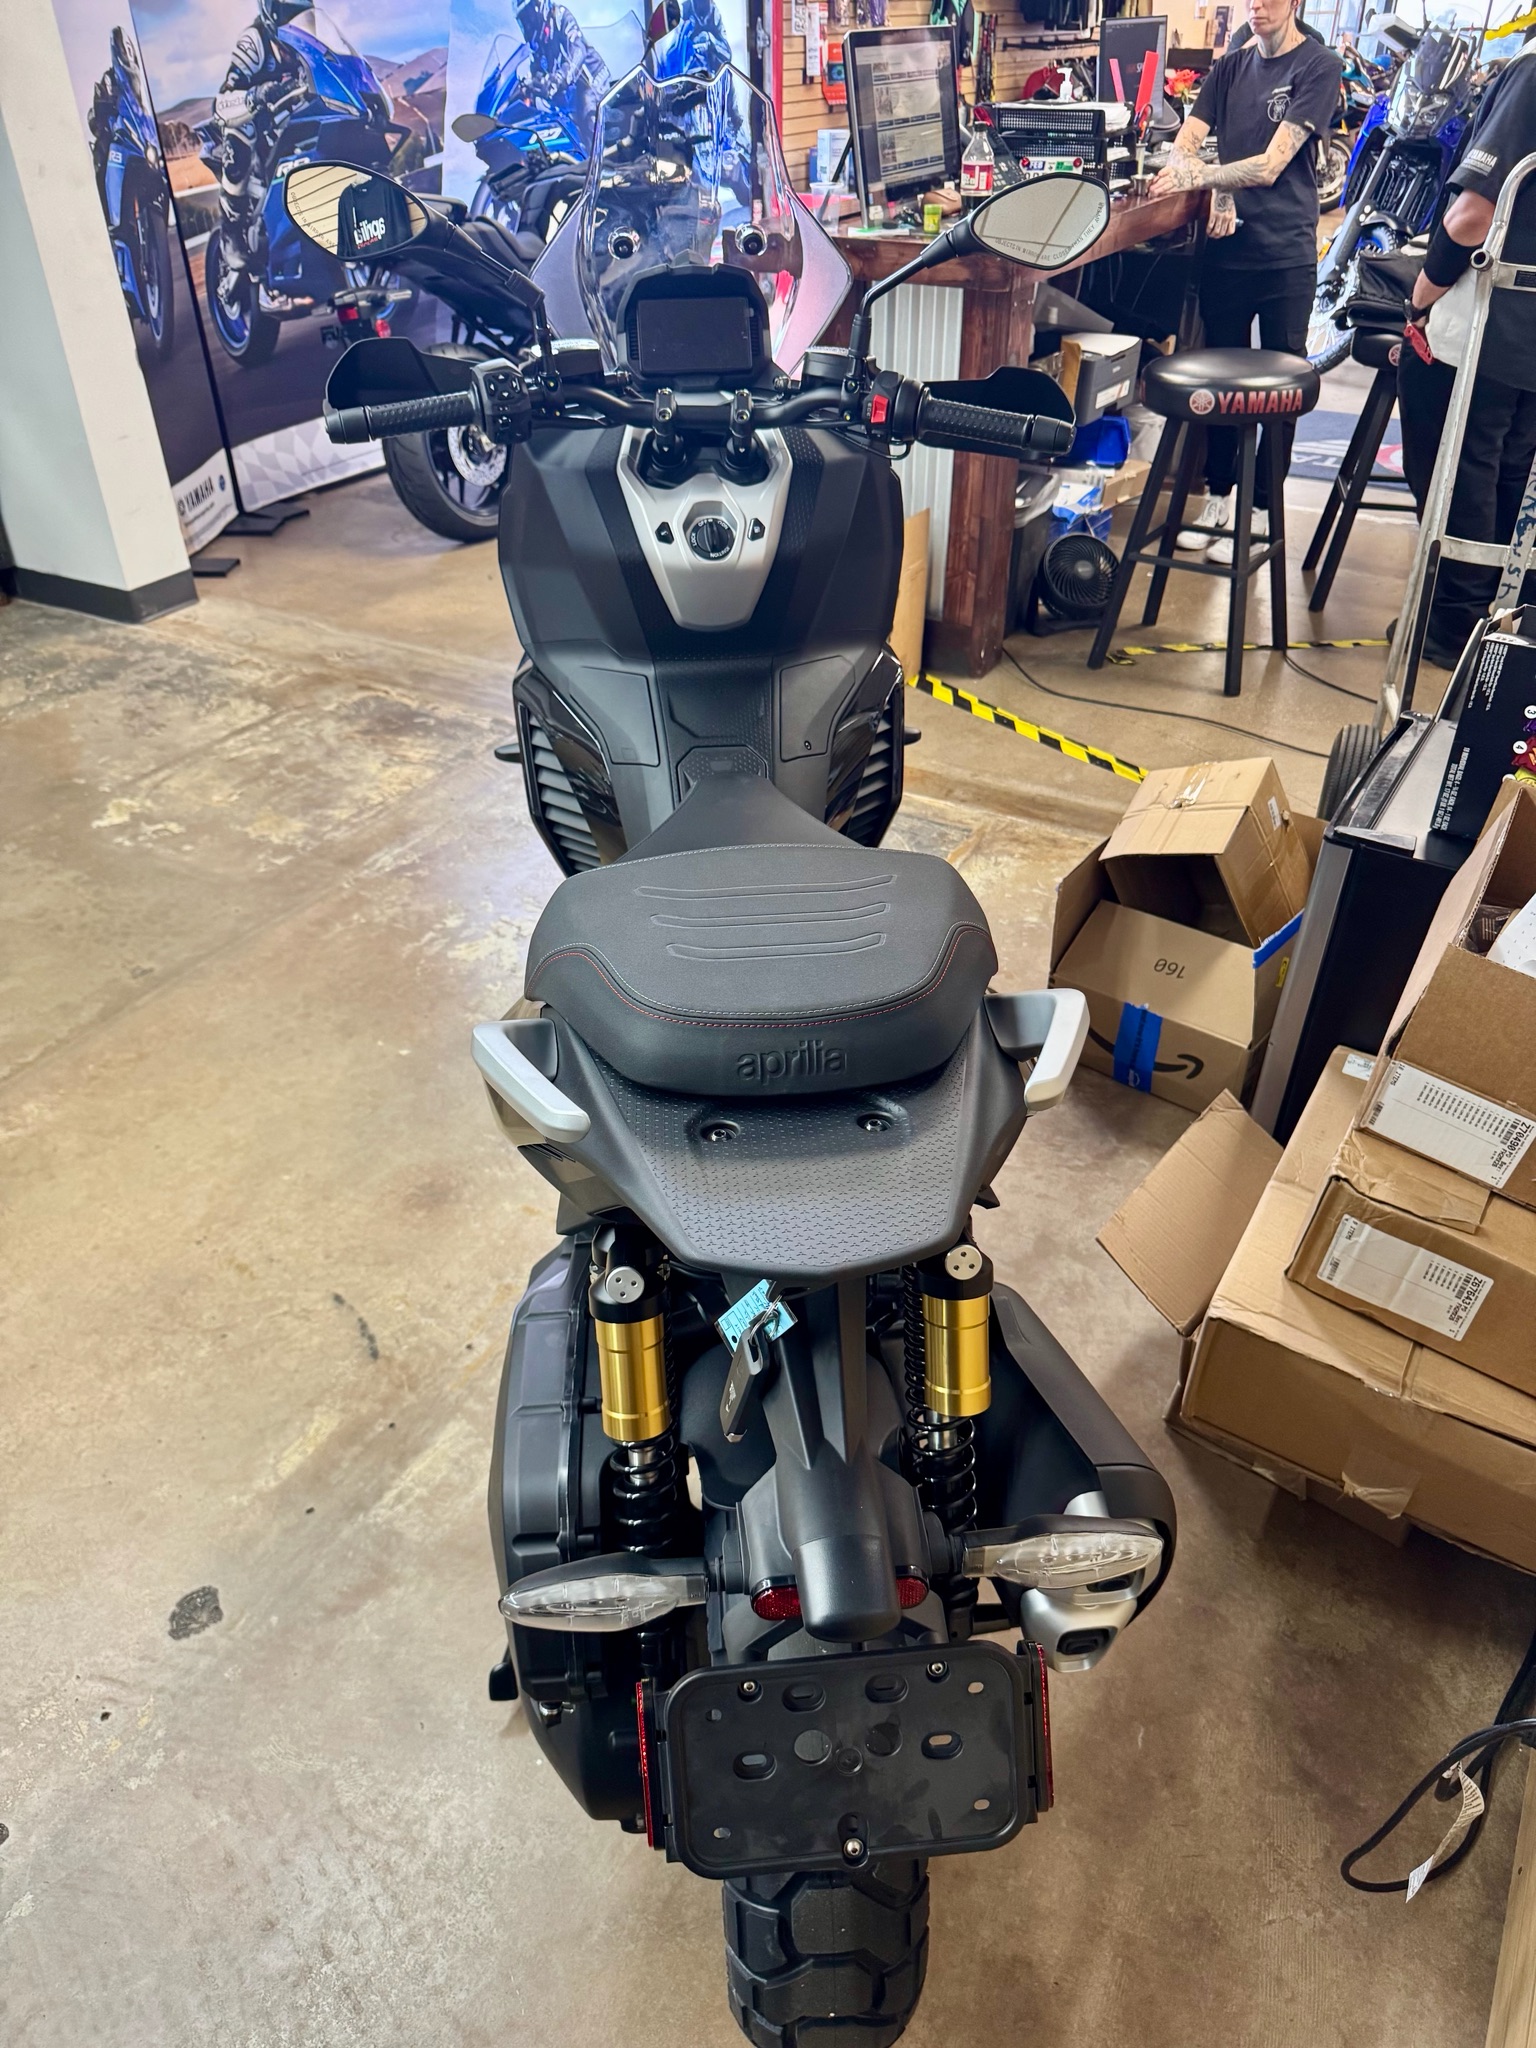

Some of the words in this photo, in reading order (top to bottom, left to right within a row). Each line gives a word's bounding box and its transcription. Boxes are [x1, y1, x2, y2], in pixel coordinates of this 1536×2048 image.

[1218, 388, 1303, 414] YAMAHA
[184, 476, 214, 513] YAMAHA
[1154, 958, 1185, 979] 160
[737, 1039, 847, 1086] aprilia
[1506, 1121, 1531, 1152] Z70490
[1460, 1276, 1482, 1306] Z67643
